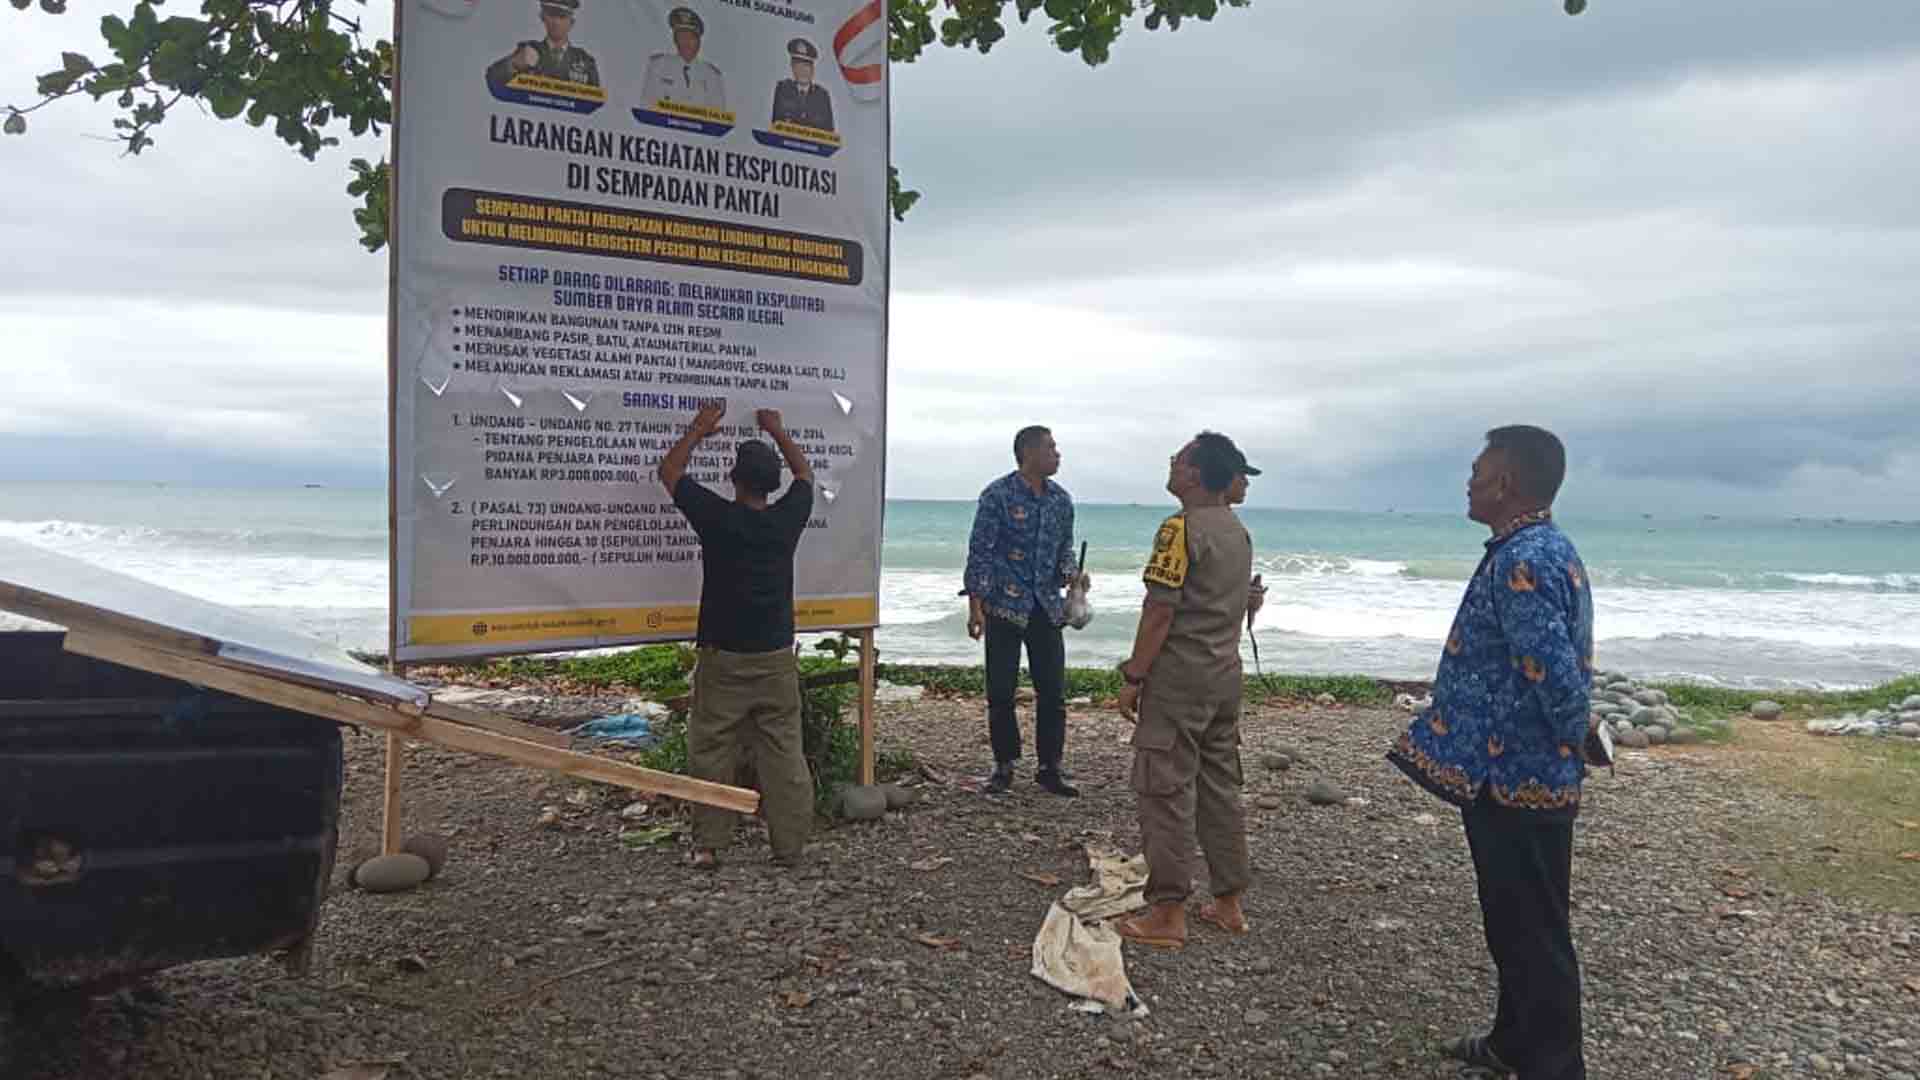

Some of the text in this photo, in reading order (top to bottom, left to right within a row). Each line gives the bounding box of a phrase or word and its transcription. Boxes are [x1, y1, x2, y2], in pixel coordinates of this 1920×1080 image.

[489, 114, 837, 196] LARANGAN KEGIATAN EKSPLOITASI
[567, 162, 780, 218] DI SEMPADAN PANTAI
[475, 197, 545, 221] SEMPADAN
[548, 206, 590, 226] PANTAI
[592, 211, 664, 235] MERUPAKAN
[462, 218, 506, 238] UNTUK
[509, 223, 584, 247] MELINDUNGI
[587, 232, 652, 255] EKOSISTEM
[498, 264, 825, 312] SETIAP ORANG DILARANG: MELAKUKAN EKSPLOITASI
[464, 306, 722, 338] MENDIRIKAN BANGUNAN TANPA IZIN RESMI
[553, 290, 785, 326] SUMBER DAYA ALAM SECARA ILEGAL
[464, 324, 550, 342] MENAMBANG
[553, 331, 593, 347] PASIR,
[596, 335, 630, 349] BATU,
[719, 344, 758, 358] PANTAI
[464, 342, 529, 358] MERUSAK
[533, 346, 591, 362] VEGETASI
[594, 350, 632, 364] ALAMI
[635, 353, 677, 368] PANTAI
[686, 358, 749, 373] MANGROVE,
[751, 363, 794, 377] CEMARA
[464, 359, 790, 391] MELAKUKAN REKLAMASI ATAU PENIMBUNAN TANPA IZIN
[622, 392, 674, 409] SANKSI
[470, 415, 525, 429] UNDANG
[539, 417, 592, 431] UNDANG
[594, 421, 615, 432] NO.
[618, 421, 632, 433] 27
[634, 421, 672, 434] TAHUN
[485, 432, 545, 447] TENTANG
[547, 434, 637, 449] PENGELOLAAN
[485, 450, 535, 464] PIDANA
[537, 451, 594, 465] PENJARA
[597, 453, 641, 466] PALING
[485, 467, 537, 481] BANYAK
[480, 502, 523, 514] PASAL
[550, 503, 657, 514] UNDANG-UNDANG
[471, 518, 572, 531] PERLINDUNGAN
[575, 519, 600, 531] DAN
[603, 519, 688, 531] PENGELOLAAN
[471, 535, 531, 548] PENJARA
[535, 535, 581, 548] HINGGA
[585, 535, 598, 548] 10
[601, 534, 662, 549] (SEPULUH)
[600, 551, 652, 564] SEPULUH
